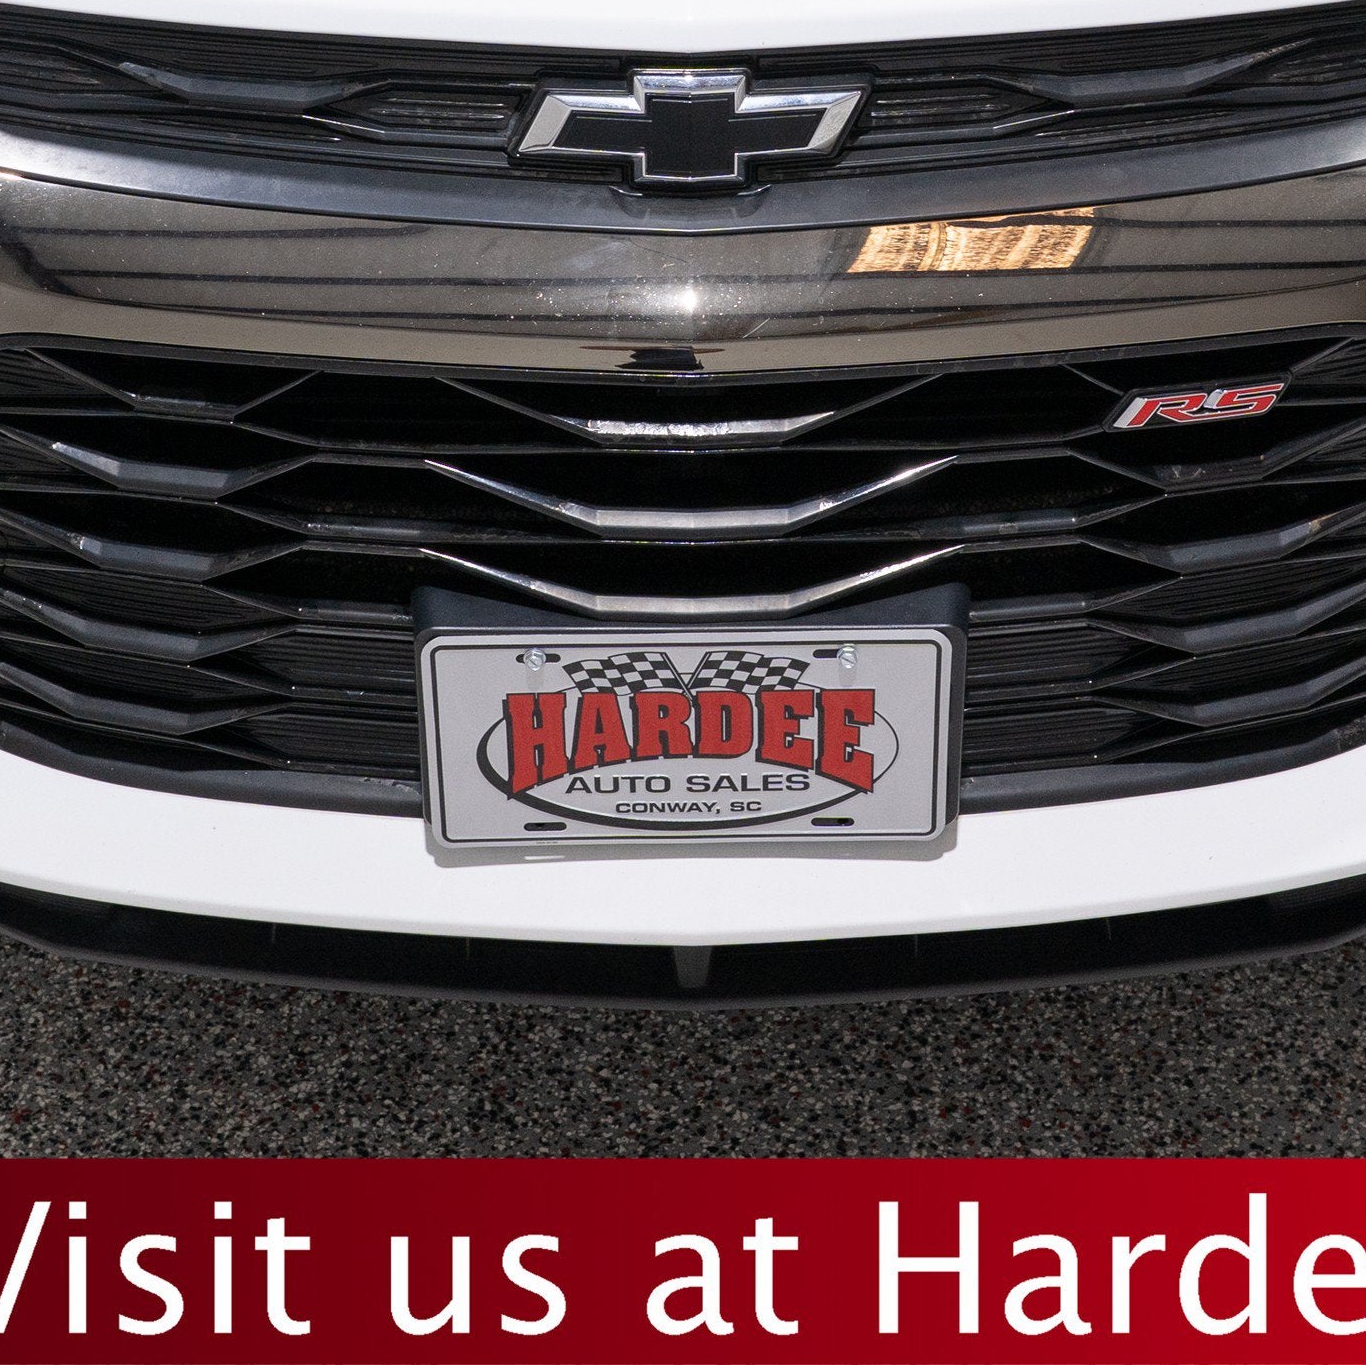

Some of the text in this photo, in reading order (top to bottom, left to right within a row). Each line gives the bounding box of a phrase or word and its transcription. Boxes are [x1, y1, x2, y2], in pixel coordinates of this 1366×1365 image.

[1113, 383, 1284, 428] RS
[502, 688, 876, 799] HARDEE
[565, 772, 811, 795] AUTO SALES
[614, 799, 762, 815] CONWAY, SC
